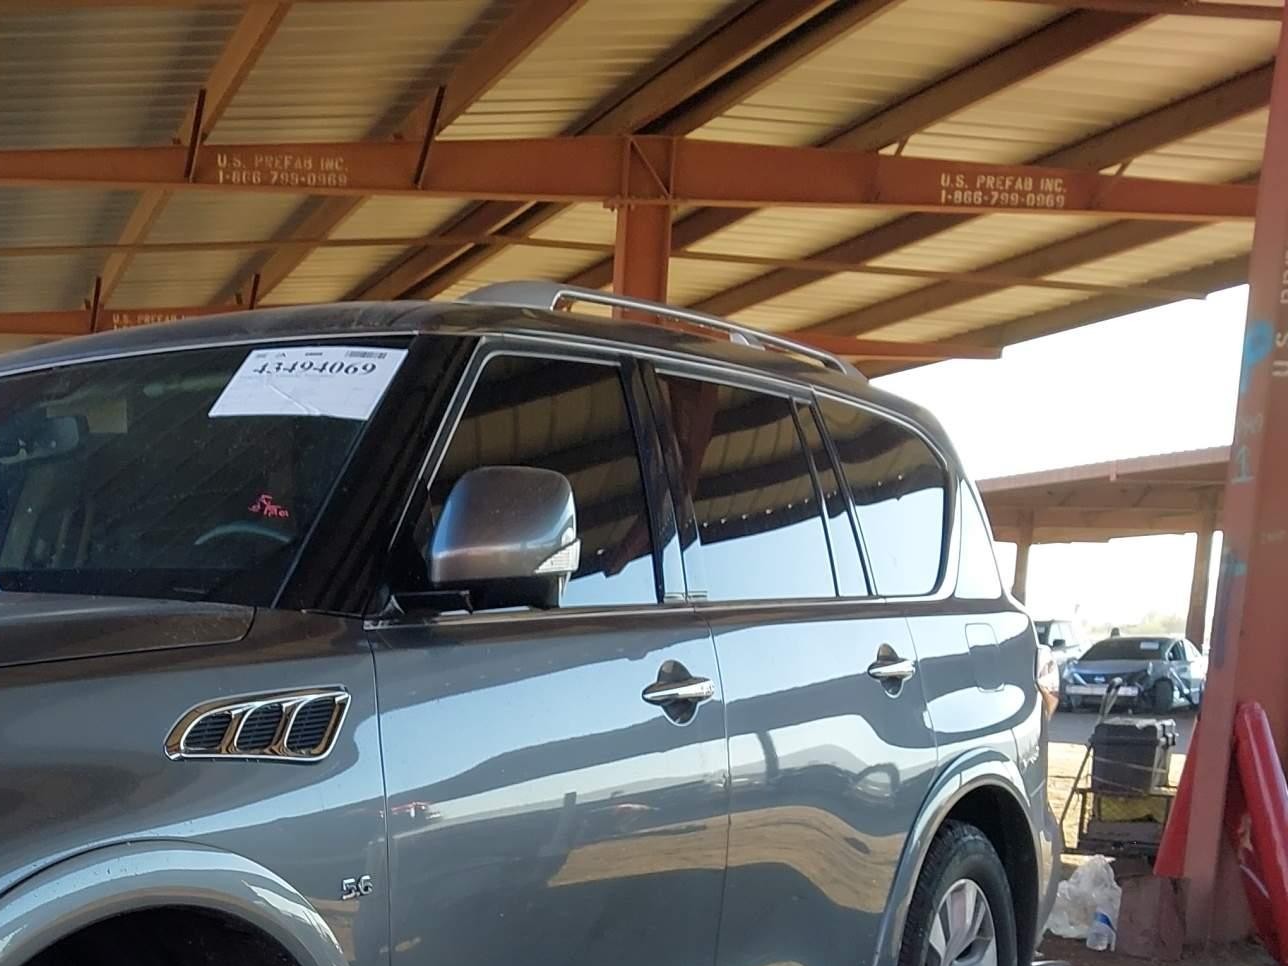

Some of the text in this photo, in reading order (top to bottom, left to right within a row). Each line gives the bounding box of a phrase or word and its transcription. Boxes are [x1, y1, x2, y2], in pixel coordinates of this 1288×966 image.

[216, 153, 348, 172] U.S. PREFAB INC.
[940, 173, 1067, 193] U.S. PREFAB INC.
[253, 360, 377, 375] 43494069
[342, 875, 373, 900] 5.6
